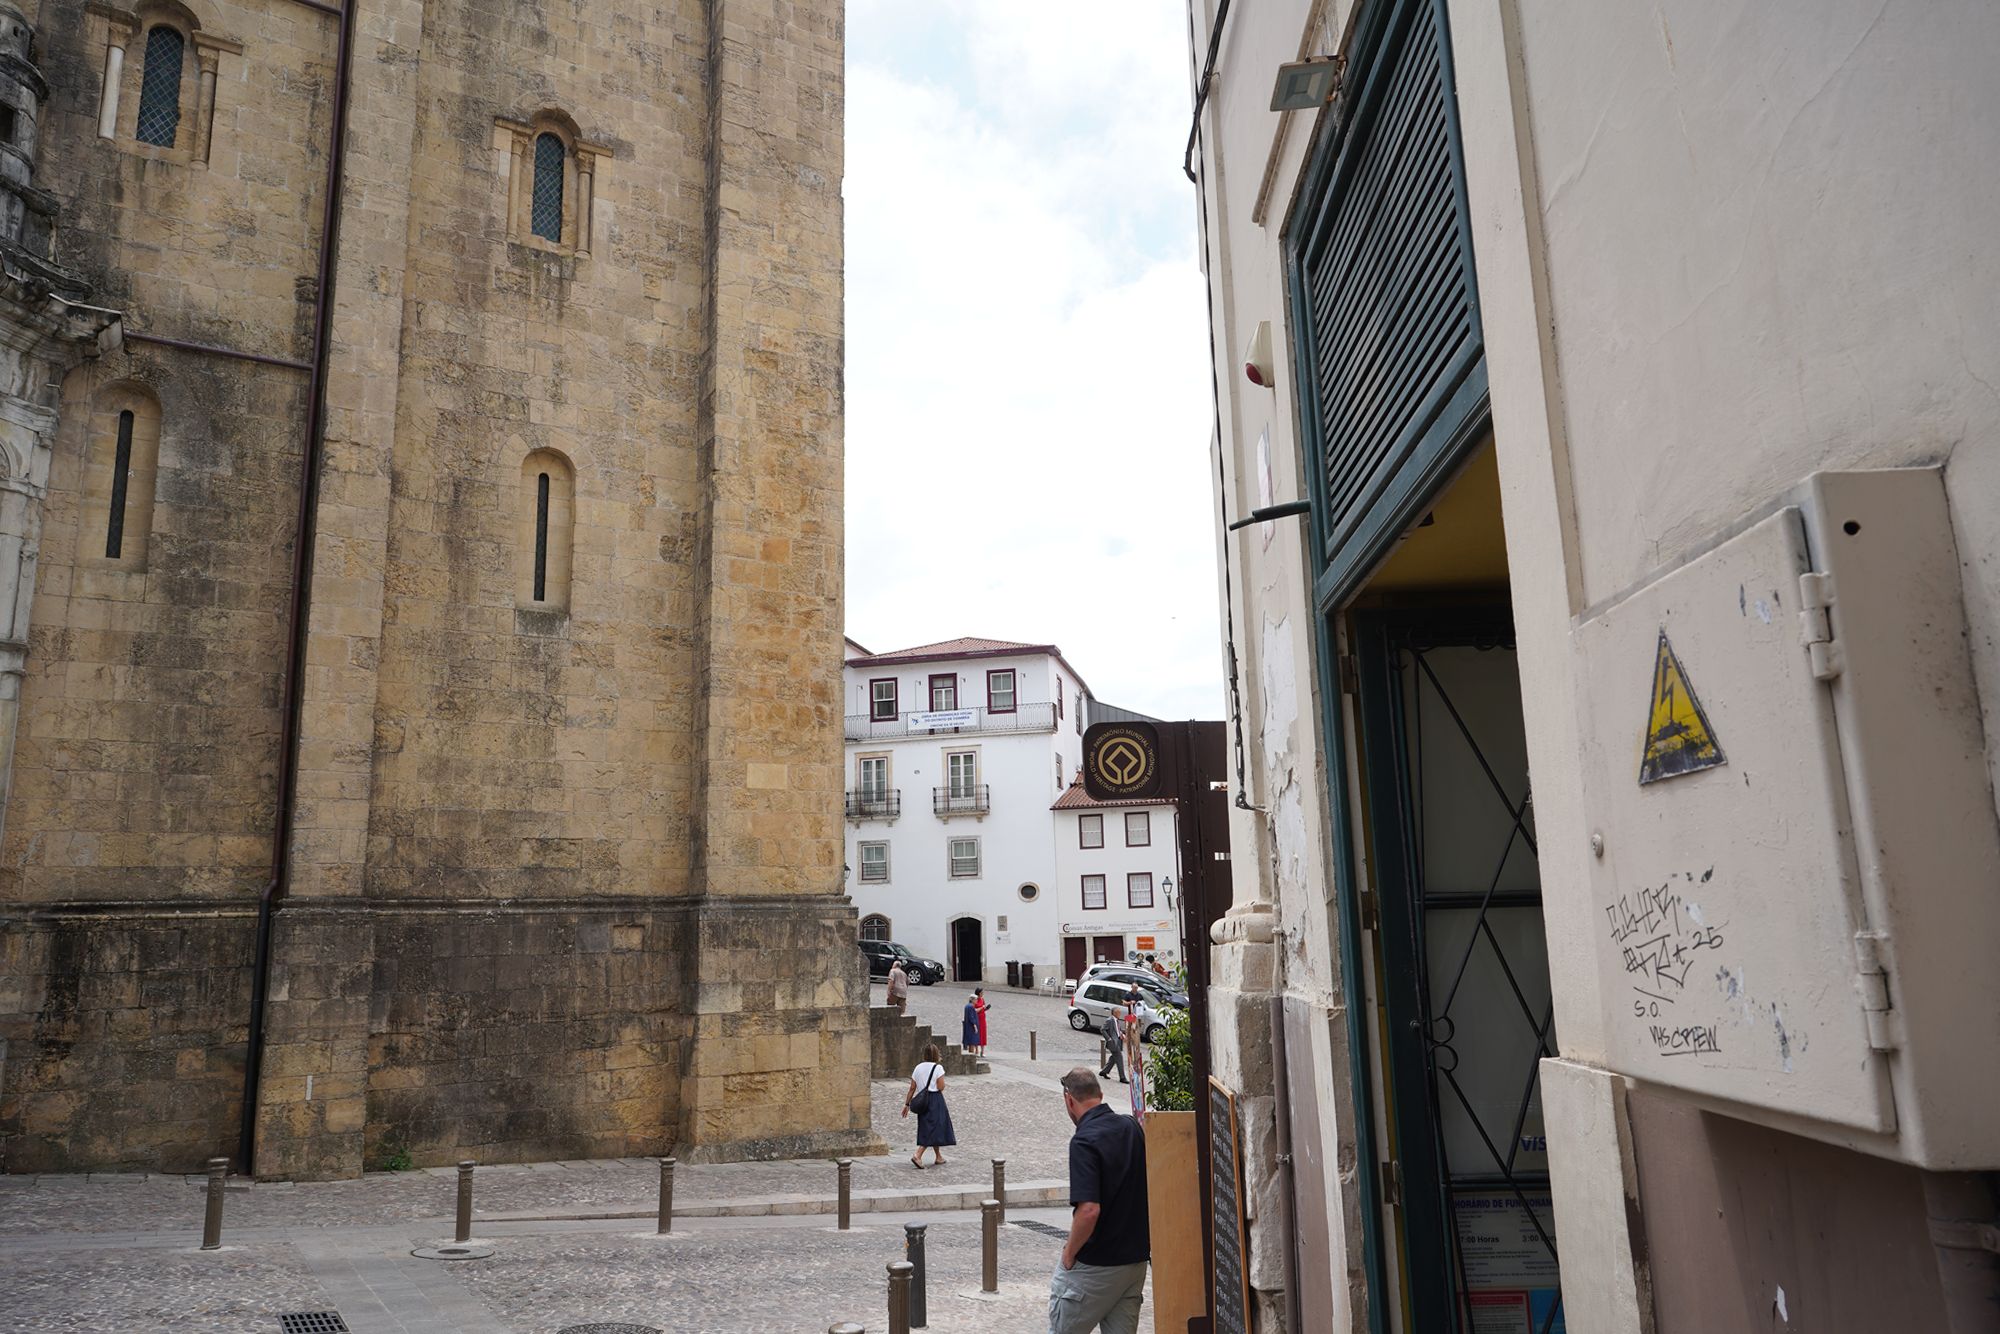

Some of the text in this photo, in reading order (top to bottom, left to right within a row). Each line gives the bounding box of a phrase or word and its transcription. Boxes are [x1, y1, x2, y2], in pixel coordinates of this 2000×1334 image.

[1094, 728, 1148, 748] PATRIMÓNIO MUNDIAL
[1094, 772, 1116, 793] HERITAGE
[1492, 1199, 1503, 1208] DE
